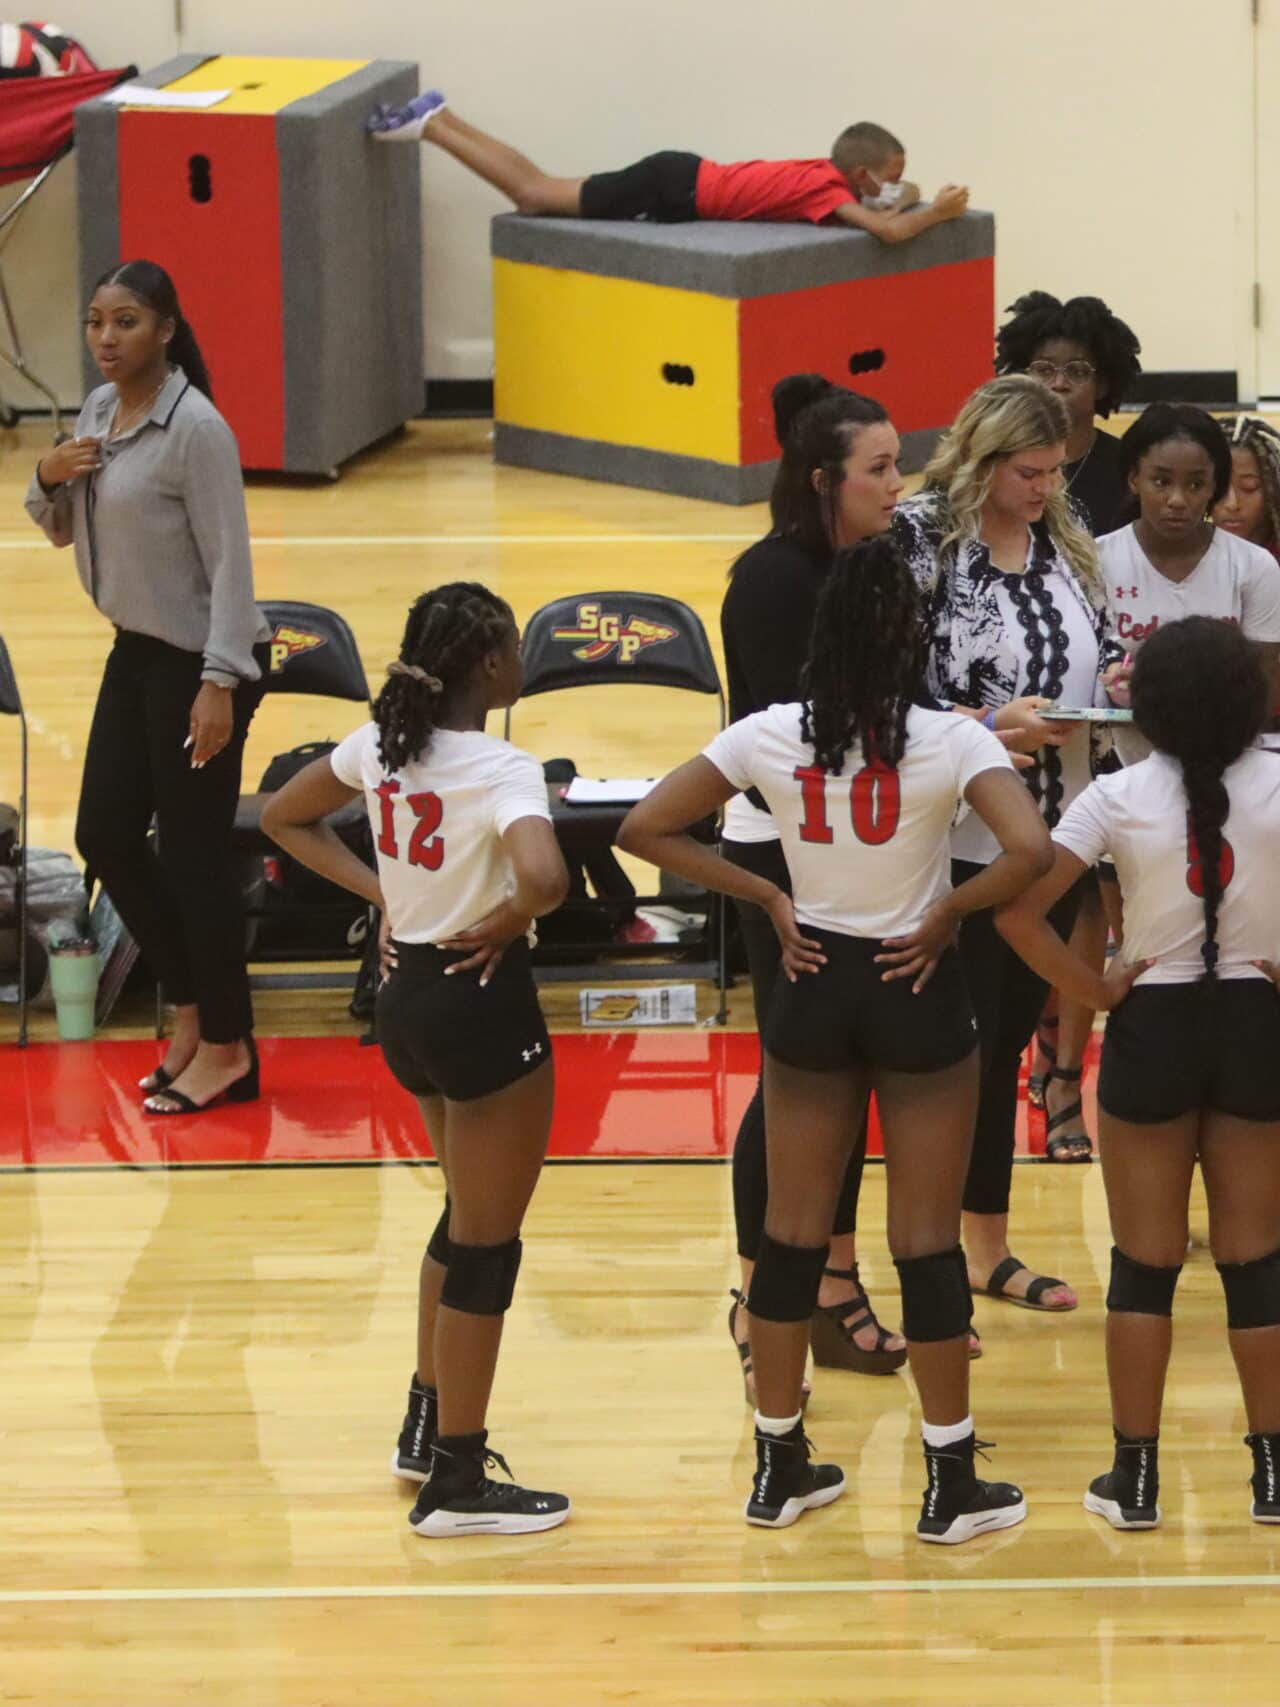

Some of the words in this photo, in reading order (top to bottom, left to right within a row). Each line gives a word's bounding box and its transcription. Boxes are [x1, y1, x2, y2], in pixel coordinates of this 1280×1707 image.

[576, 602, 641, 665] SGP
[1117, 611, 1158, 641] Ced
[373, 778, 445, 872] 12
[793, 764, 902, 846] 10
